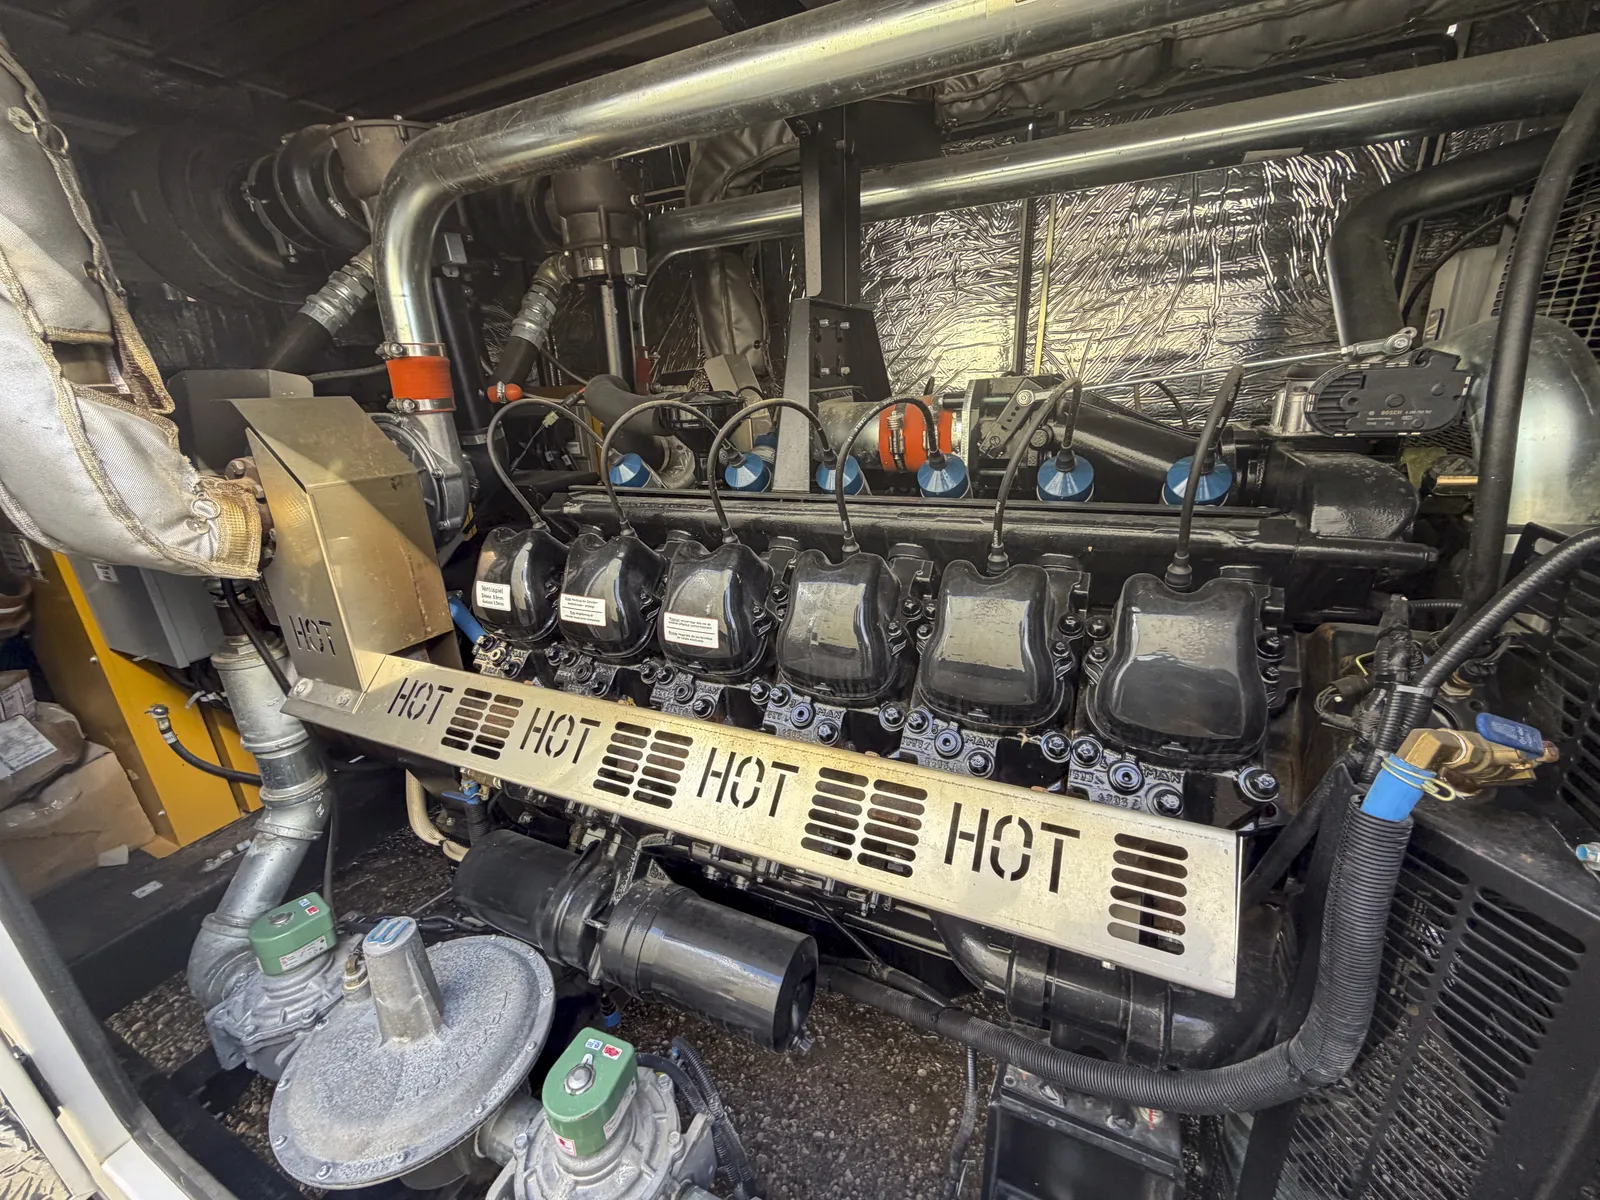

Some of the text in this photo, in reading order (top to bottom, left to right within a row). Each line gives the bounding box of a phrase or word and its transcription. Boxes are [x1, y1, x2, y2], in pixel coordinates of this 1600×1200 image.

[853, 416, 867, 432] CABLE
[289, 615, 336, 656] HOT
[387, 677, 454, 725] HOT
[815, 707, 844, 719] MAN
[519, 707, 601, 764] HOT
[964, 734, 996, 749] MAN
[697, 747, 800, 817] HOT
[1142, 764, 1183, 784] MAN
[944, 802, 1081, 894] HOT
